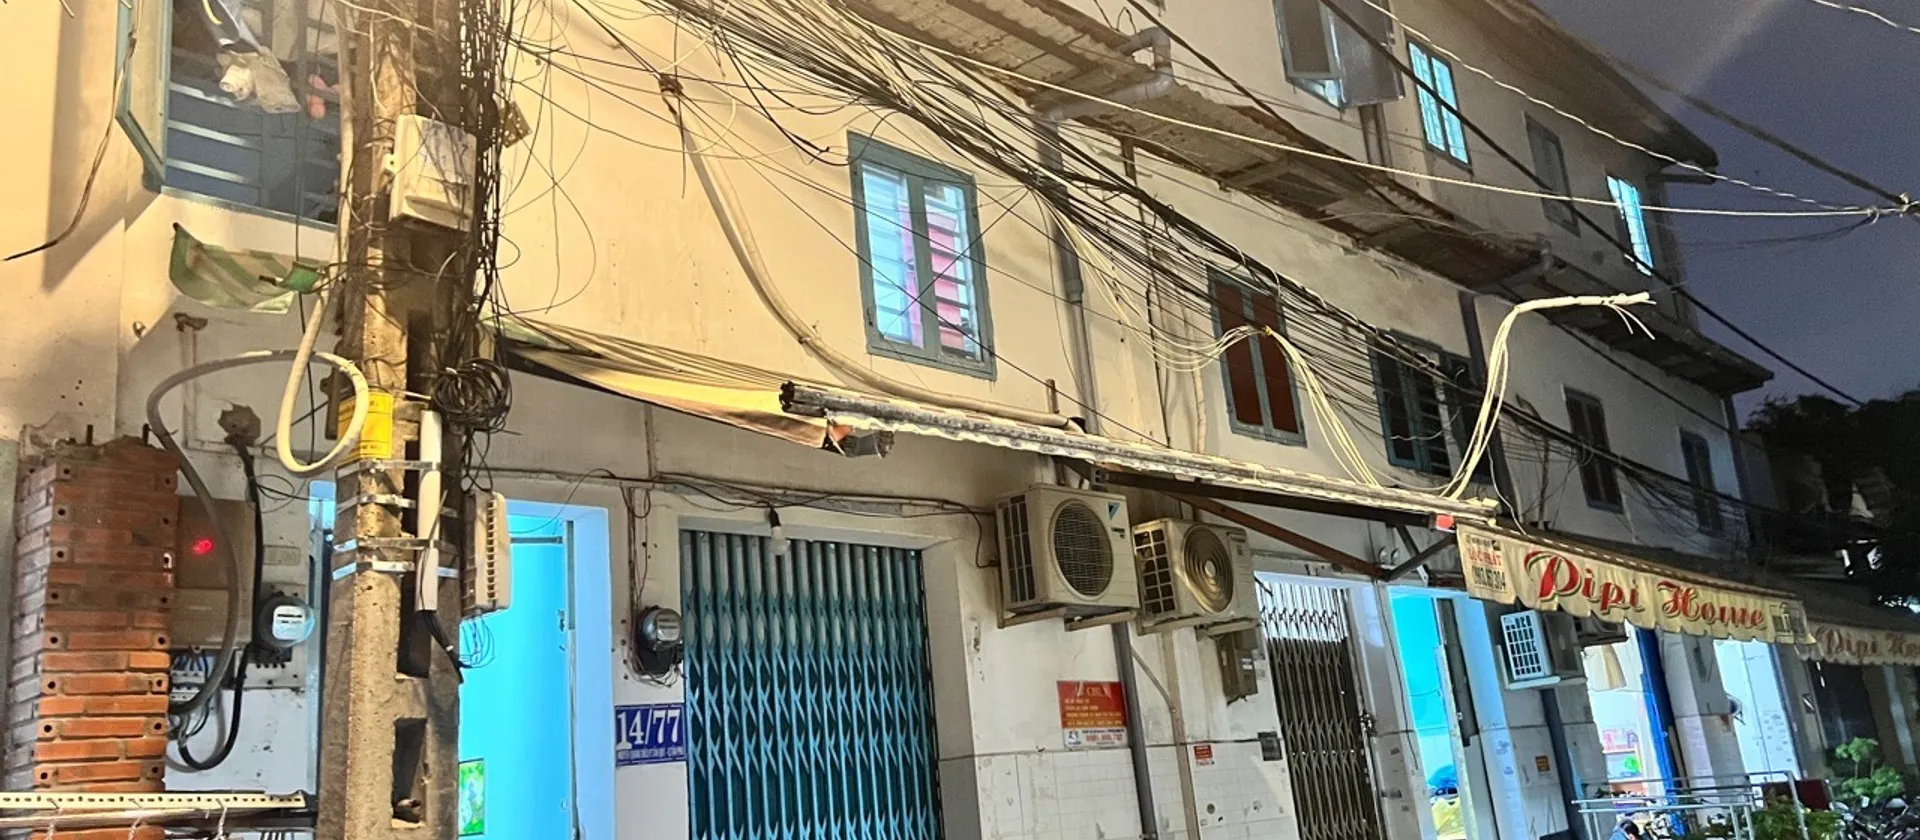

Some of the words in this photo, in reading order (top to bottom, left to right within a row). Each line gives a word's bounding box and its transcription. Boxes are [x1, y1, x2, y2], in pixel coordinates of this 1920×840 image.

[1524, 550, 1645, 615] Pipi
[1657, 580, 1767, 631] Home
[1815, 625, 1880, 664] Pipi
[616, 708, 681, 750] 14/77
